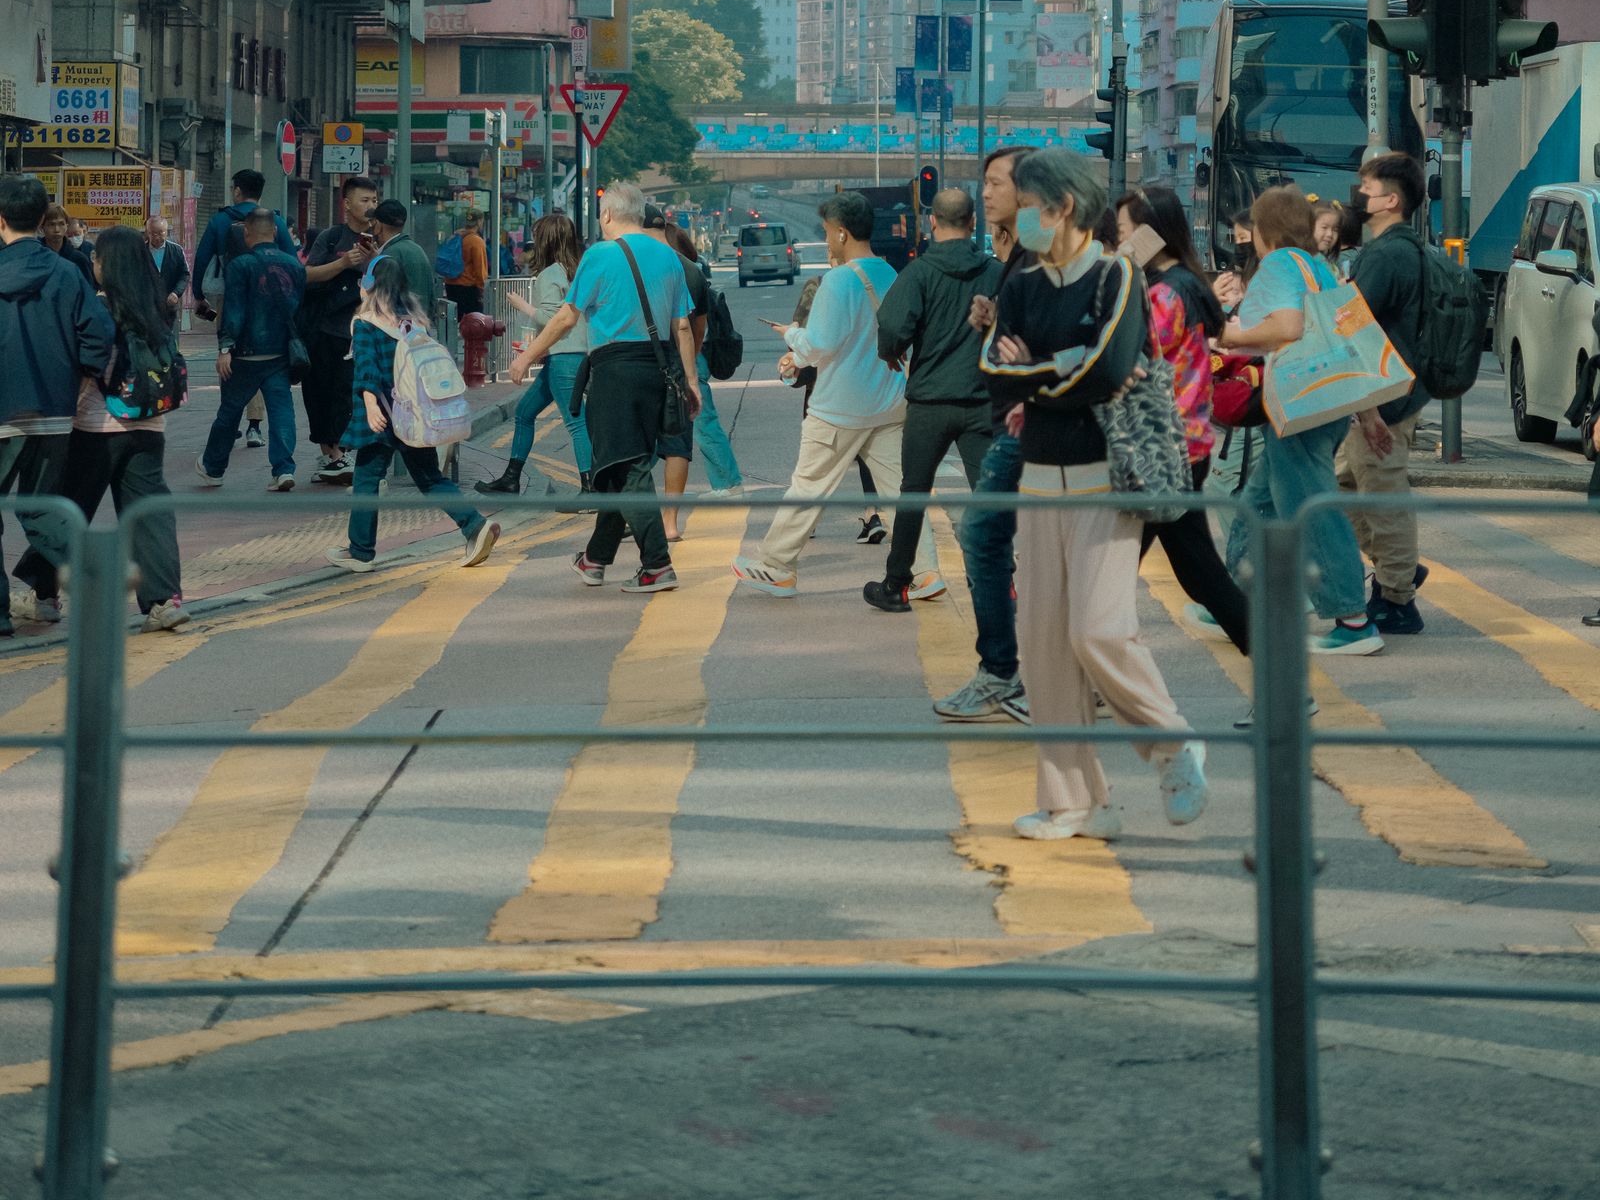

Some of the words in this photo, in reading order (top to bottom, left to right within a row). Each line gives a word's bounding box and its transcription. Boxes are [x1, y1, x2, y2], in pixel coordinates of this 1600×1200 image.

[65, 65, 103, 74] Mutual
[355, 61, 399, 71] EAD
[65, 75, 112, 85] Property
[56, 89, 109, 109] 6681
[584, 92, 606, 101] GIVE
[584, 102, 605, 110] WAY
[51, 114, 89, 124] ease
[92, 110, 108, 124] 租
[348, 147, 355, 156] 7
[348, 161, 360, 171] 12
[89, 172, 142, 187] 美聯旺舖
